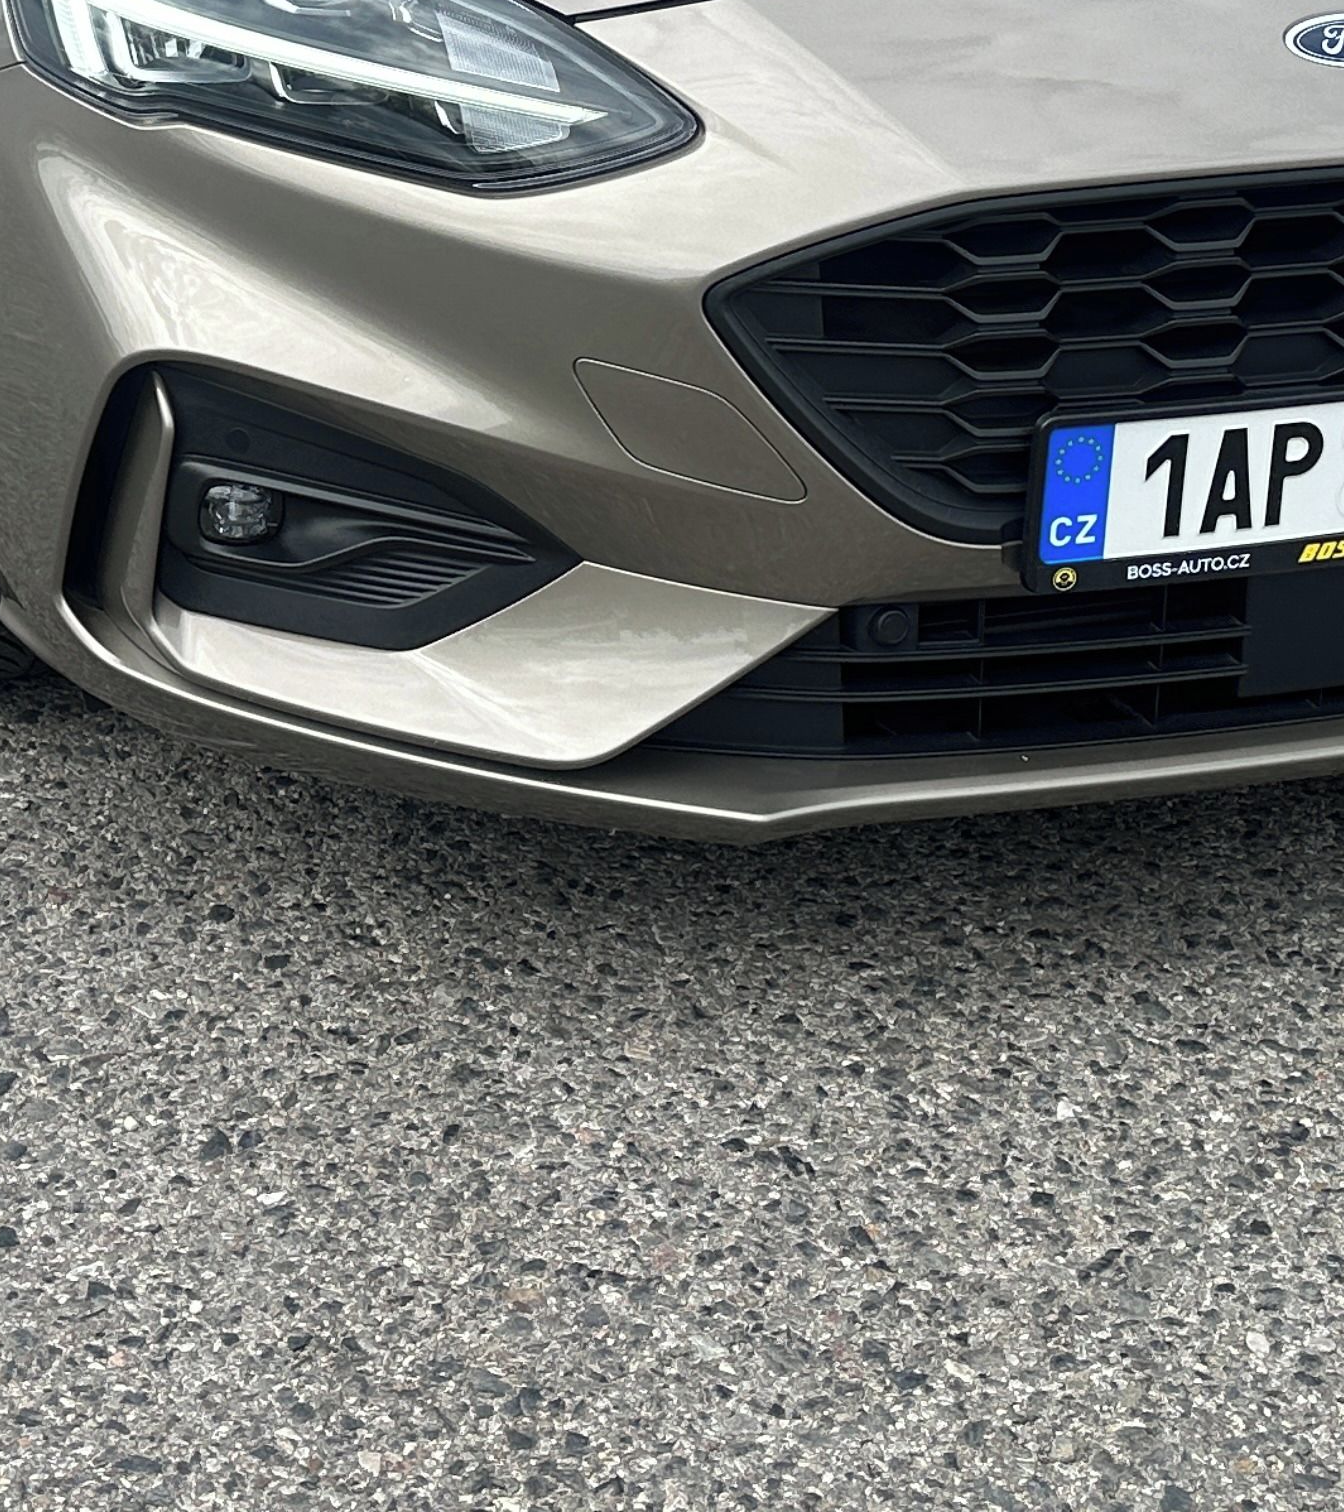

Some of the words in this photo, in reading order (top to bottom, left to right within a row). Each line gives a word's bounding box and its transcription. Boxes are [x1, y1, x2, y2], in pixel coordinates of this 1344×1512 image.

[1143, 420, 1325, 540] 1AP
[1049, 513, 1099, 547] CZ
[1127, 553, 1251, 581] BOSS-AUTO.CZ
